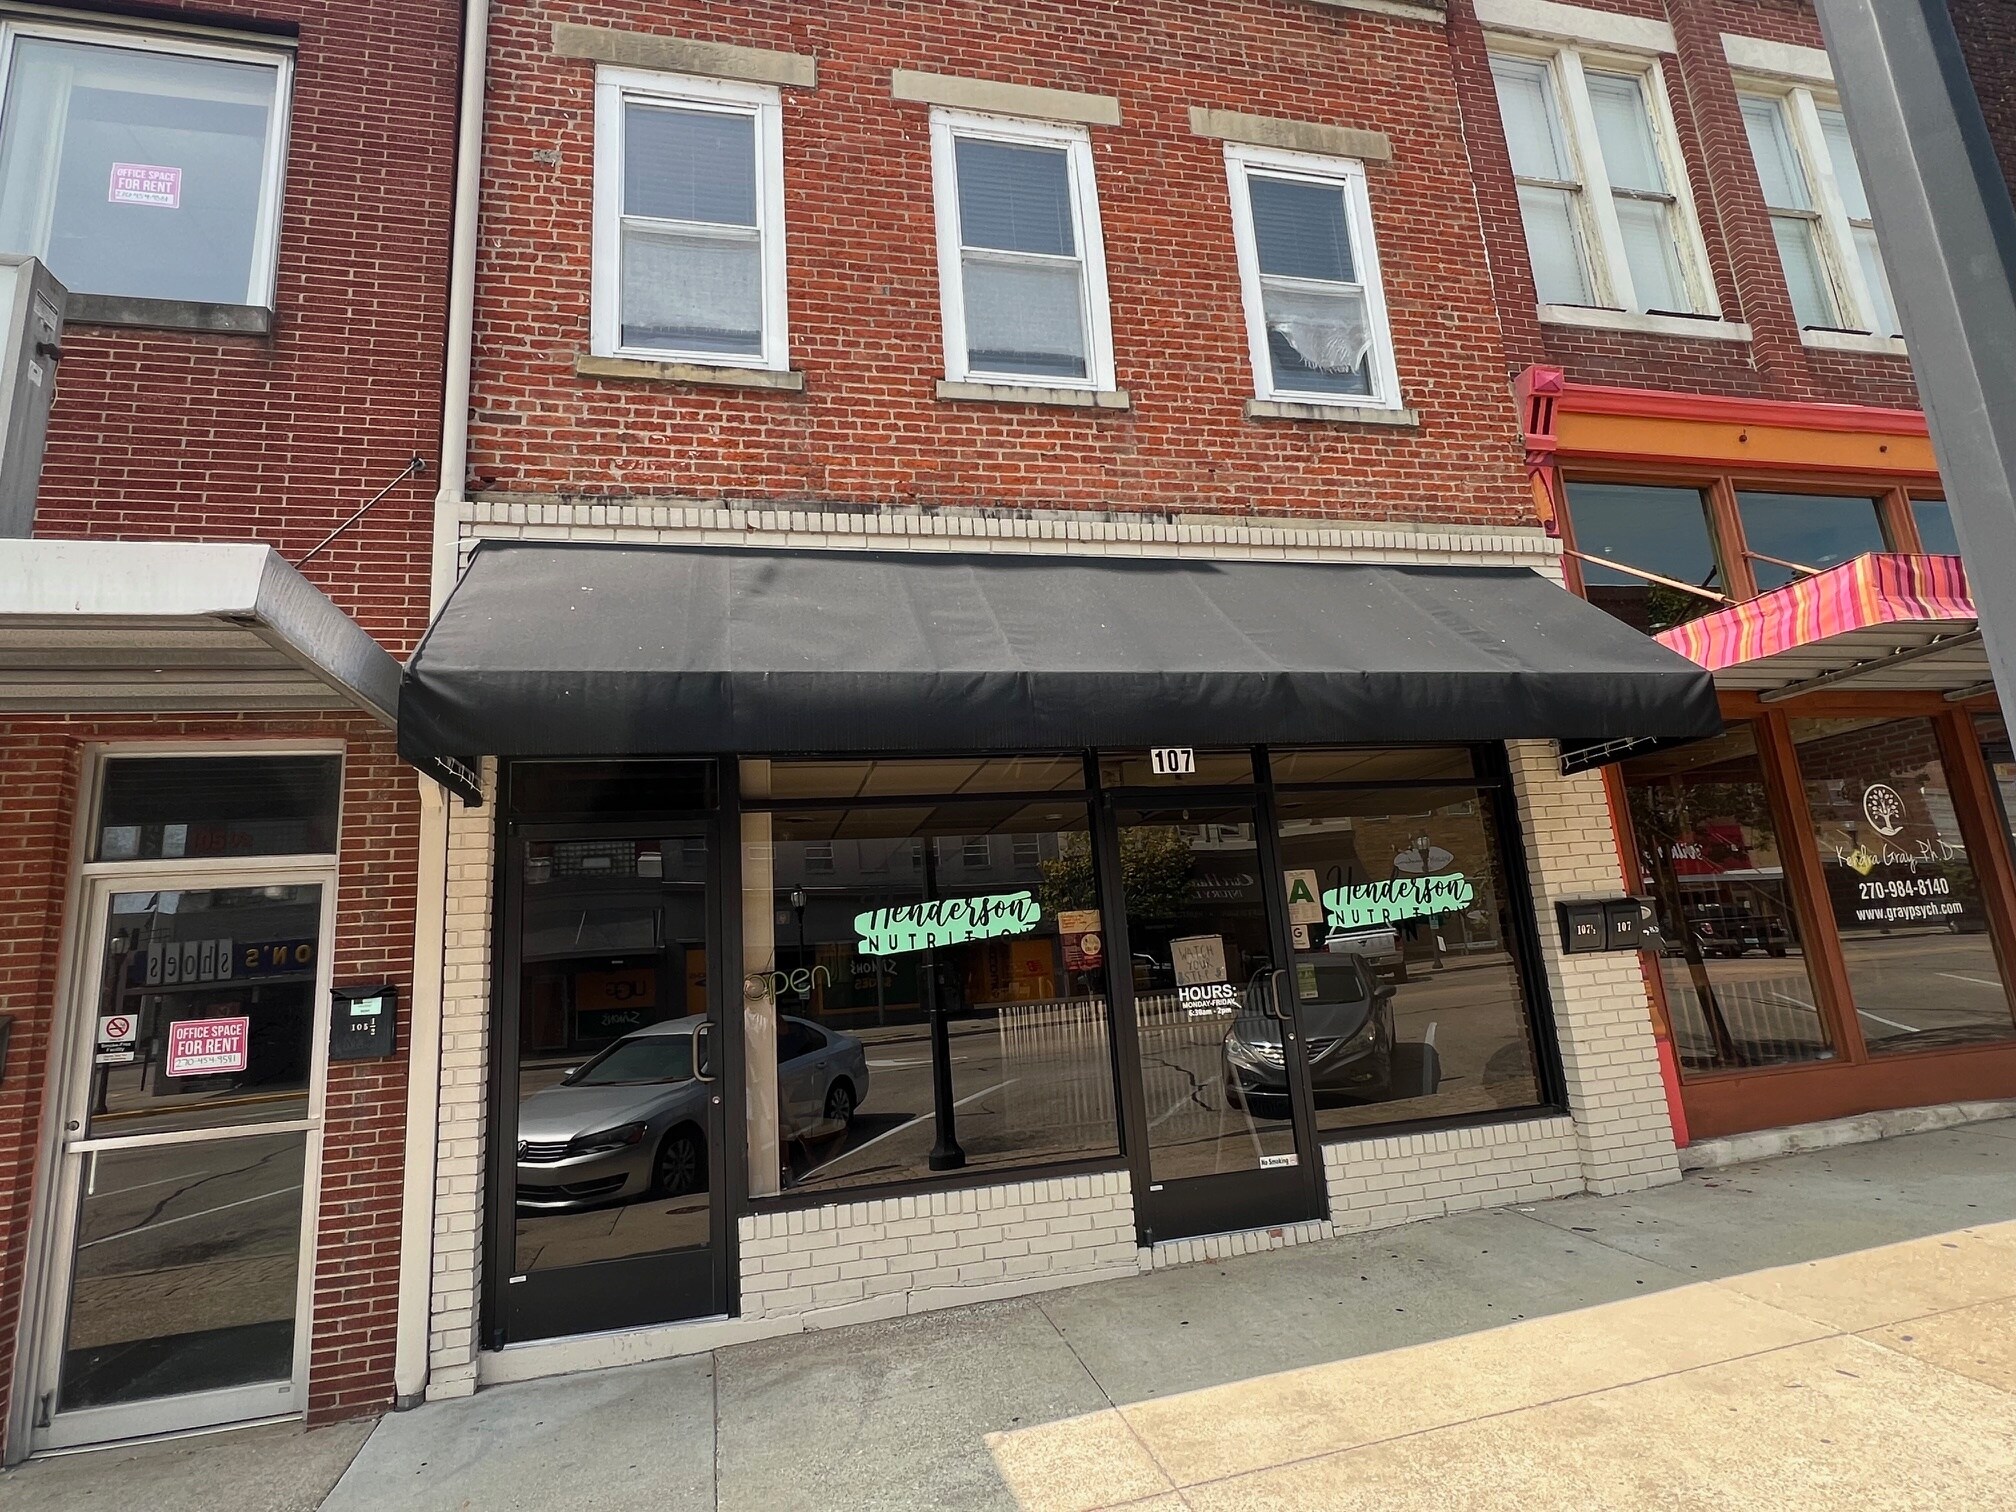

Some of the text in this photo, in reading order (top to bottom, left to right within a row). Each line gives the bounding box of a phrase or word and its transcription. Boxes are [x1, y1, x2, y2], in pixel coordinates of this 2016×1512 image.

[117, 168, 176, 182] OFFICE SPACE
[118, 177, 172, 193] FOR RENT
[1155, 750, 1190, 772] 107
[1836, 844, 1880, 868] Kendra
[1882, 843, 1917, 874] Gray,
[1289, 879, 1315, 903] A
[1327, 864, 1465, 906] Henderson
[1859, 878, 1949, 900] 270-984-8140
[868, 895, 1034, 930] Henderson
[1336, 905, 1466, 926] NUTRITION
[1856, 902, 1963, 921] www.graypsych.com
[1617, 921, 1631, 932] 107
[869, 926, 1032, 952] NUTRITION
[1178, 945, 1214, 960] WATCH
[1187, 959, 1214, 970] YOUR
[1179, 984, 1237, 1001] HOURS:
[1182, 998, 1236, 1009] MONDAY-FRIDAY
[1217, 1007, 1232, 1016] 2pm
[176, 1024, 242, 1039] OFFICE SPACE
[177, 1037, 240, 1055] FOR RENT
[1269, 1158, 1289, 1166] Smoking
